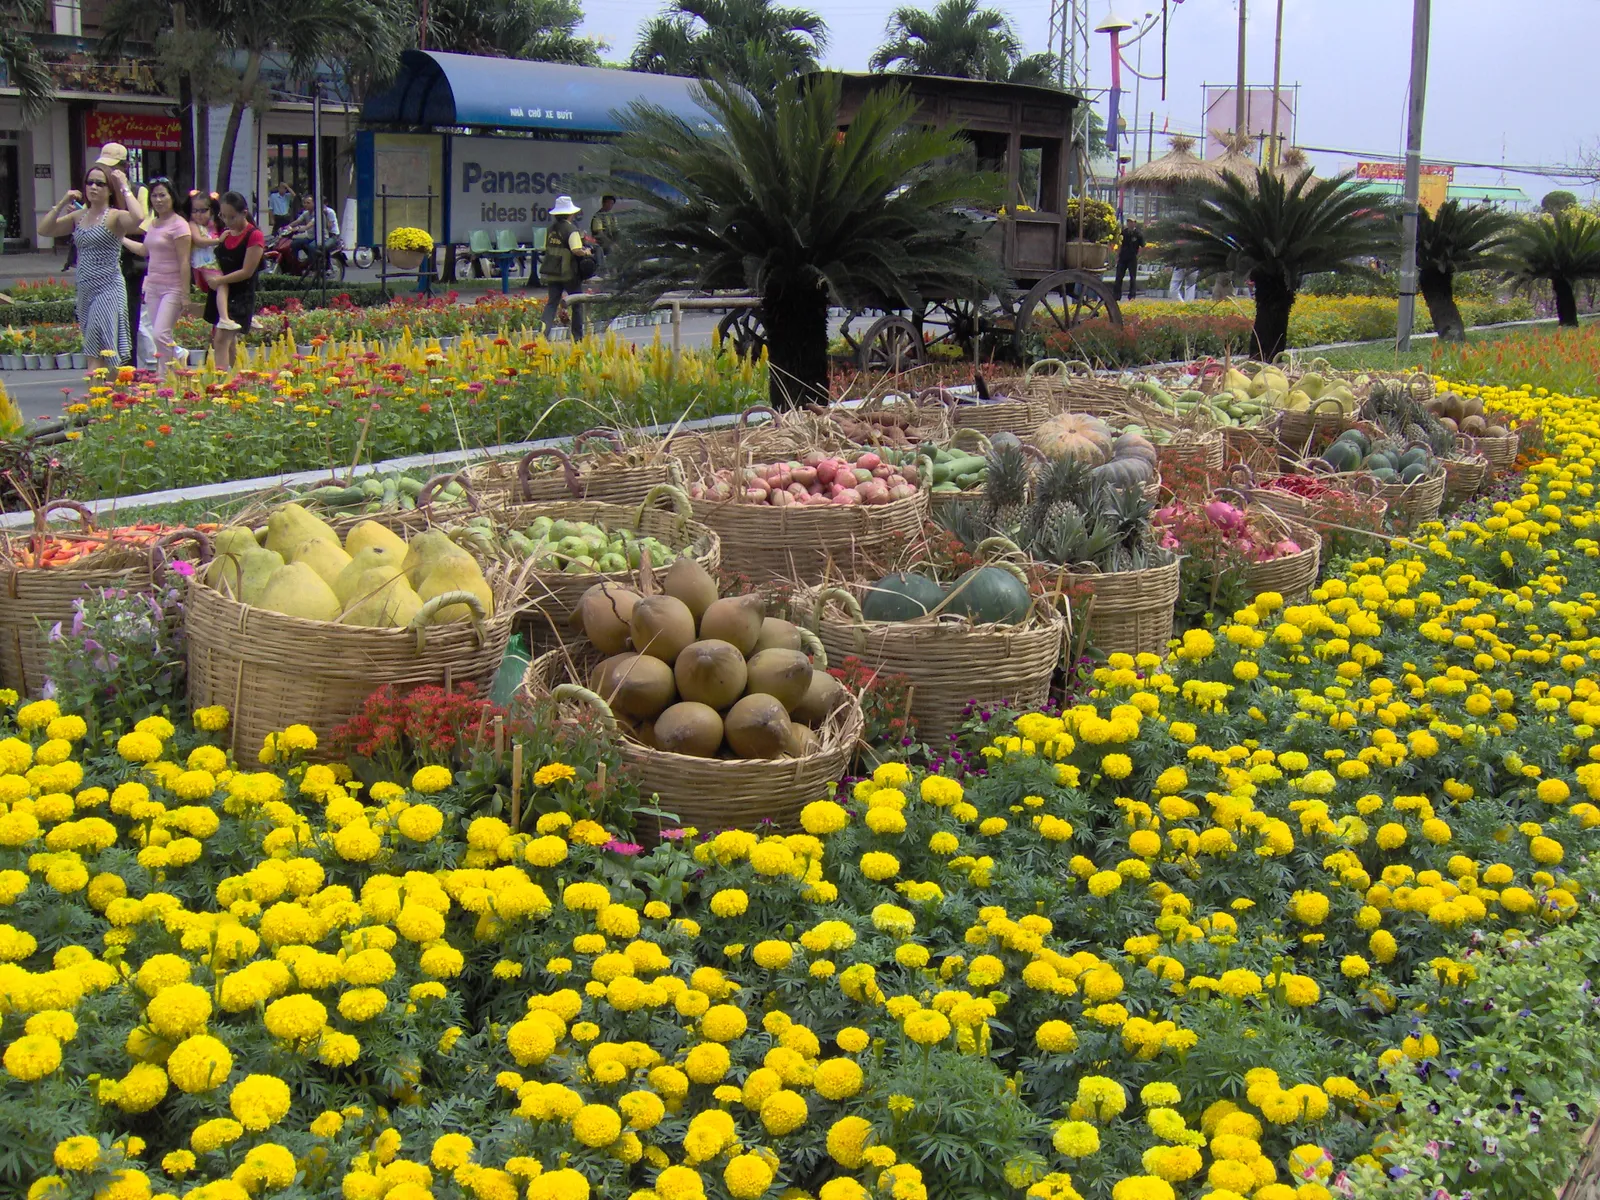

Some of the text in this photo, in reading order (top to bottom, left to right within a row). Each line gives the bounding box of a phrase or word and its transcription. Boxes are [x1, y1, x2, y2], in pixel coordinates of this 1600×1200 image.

[510, 106, 524, 117] NHÀ
[545, 109, 554, 119] XE
[481, 202, 527, 222] ideas
